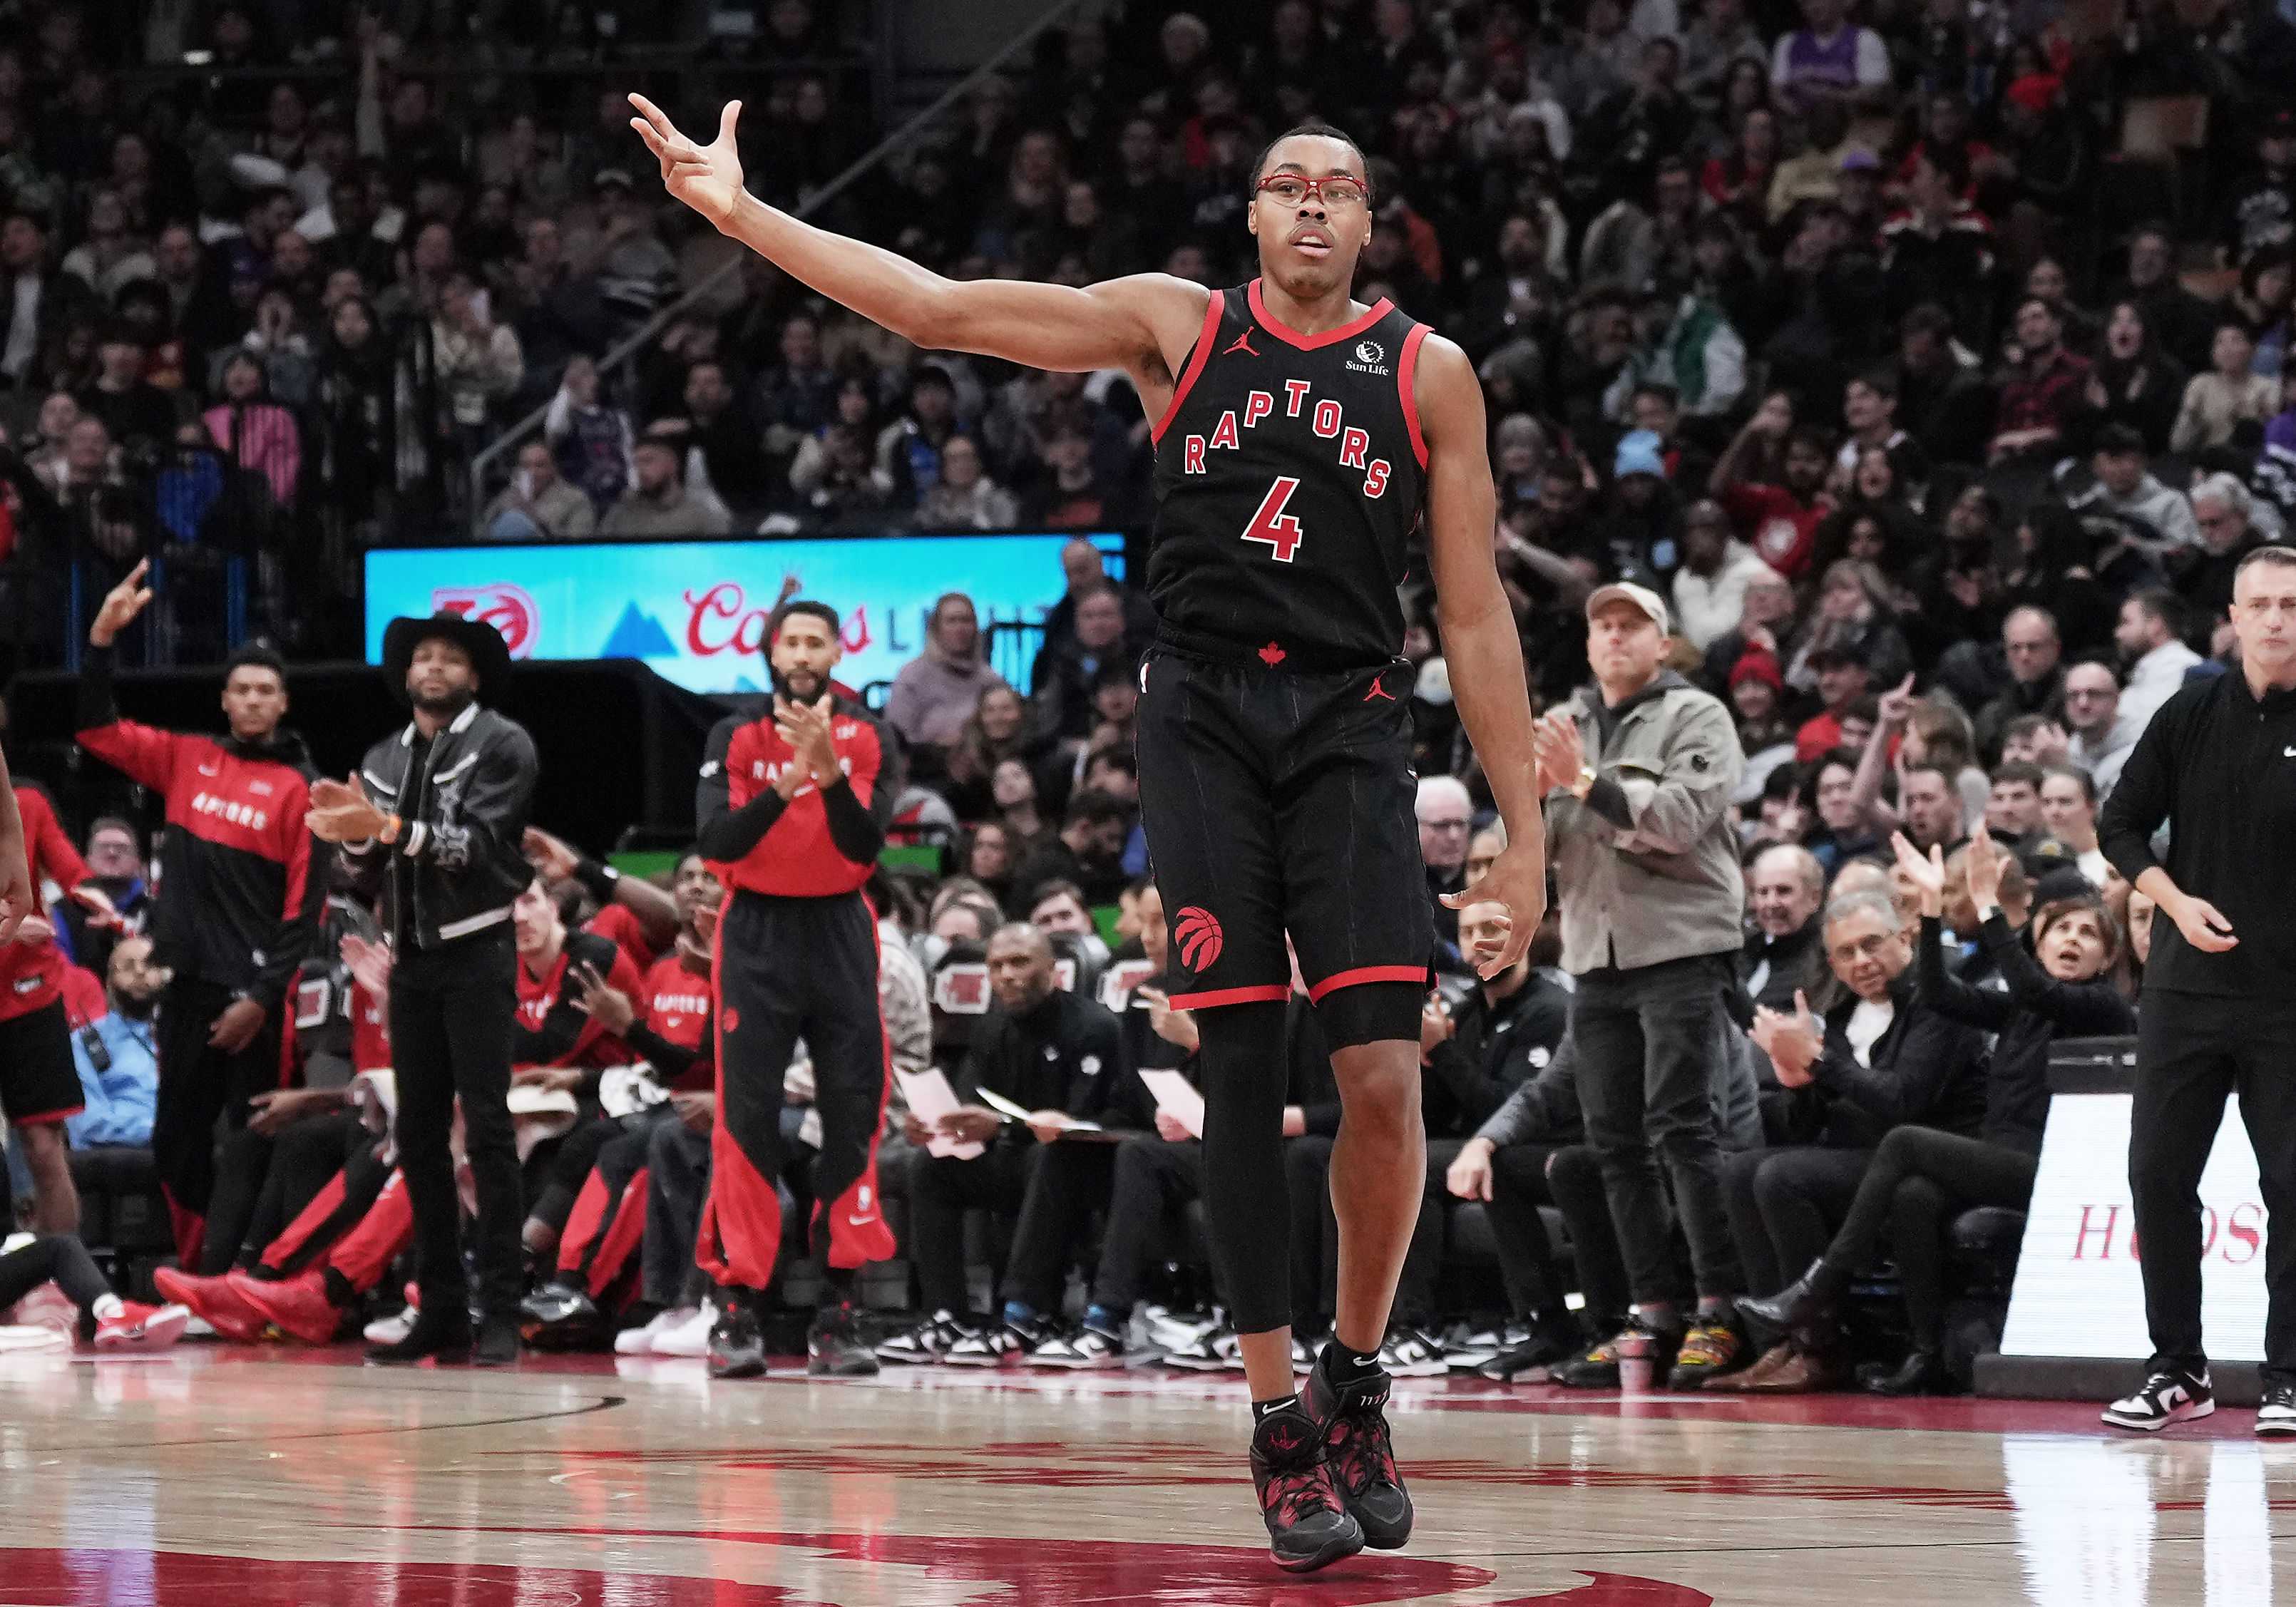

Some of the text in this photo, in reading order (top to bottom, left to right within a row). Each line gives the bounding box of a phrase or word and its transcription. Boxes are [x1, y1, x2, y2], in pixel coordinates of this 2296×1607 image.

[1346, 360, 1389, 376] Sun Life
[1184, 379, 1391, 499] RAPTORS
[1241, 476, 1303, 563] 4
[684, 582, 872, 656] Cos
